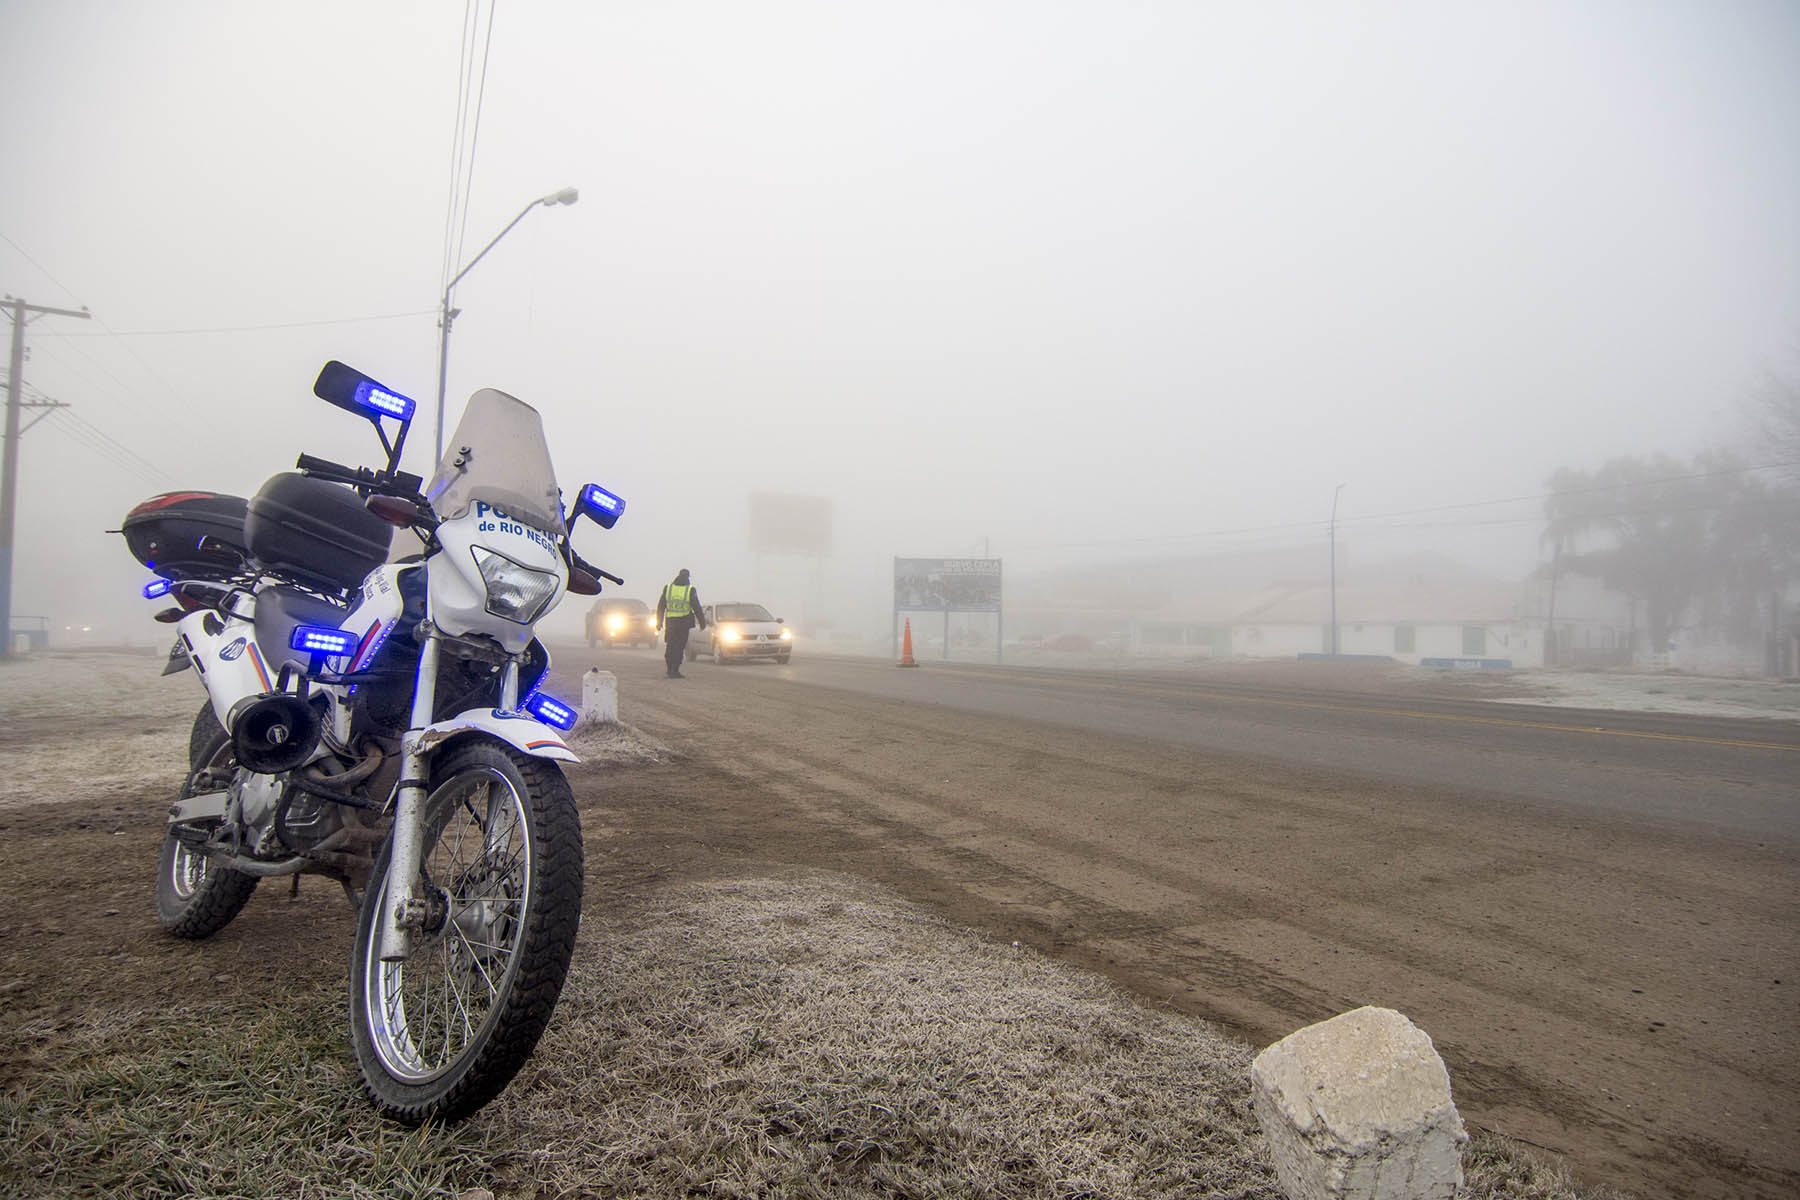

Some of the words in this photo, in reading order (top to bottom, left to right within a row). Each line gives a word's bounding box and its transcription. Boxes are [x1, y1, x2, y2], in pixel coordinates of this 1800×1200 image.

[479, 521, 495, 532] de
[500, 521, 523, 536] RIO
[527, 528, 556, 560] NEGRO
